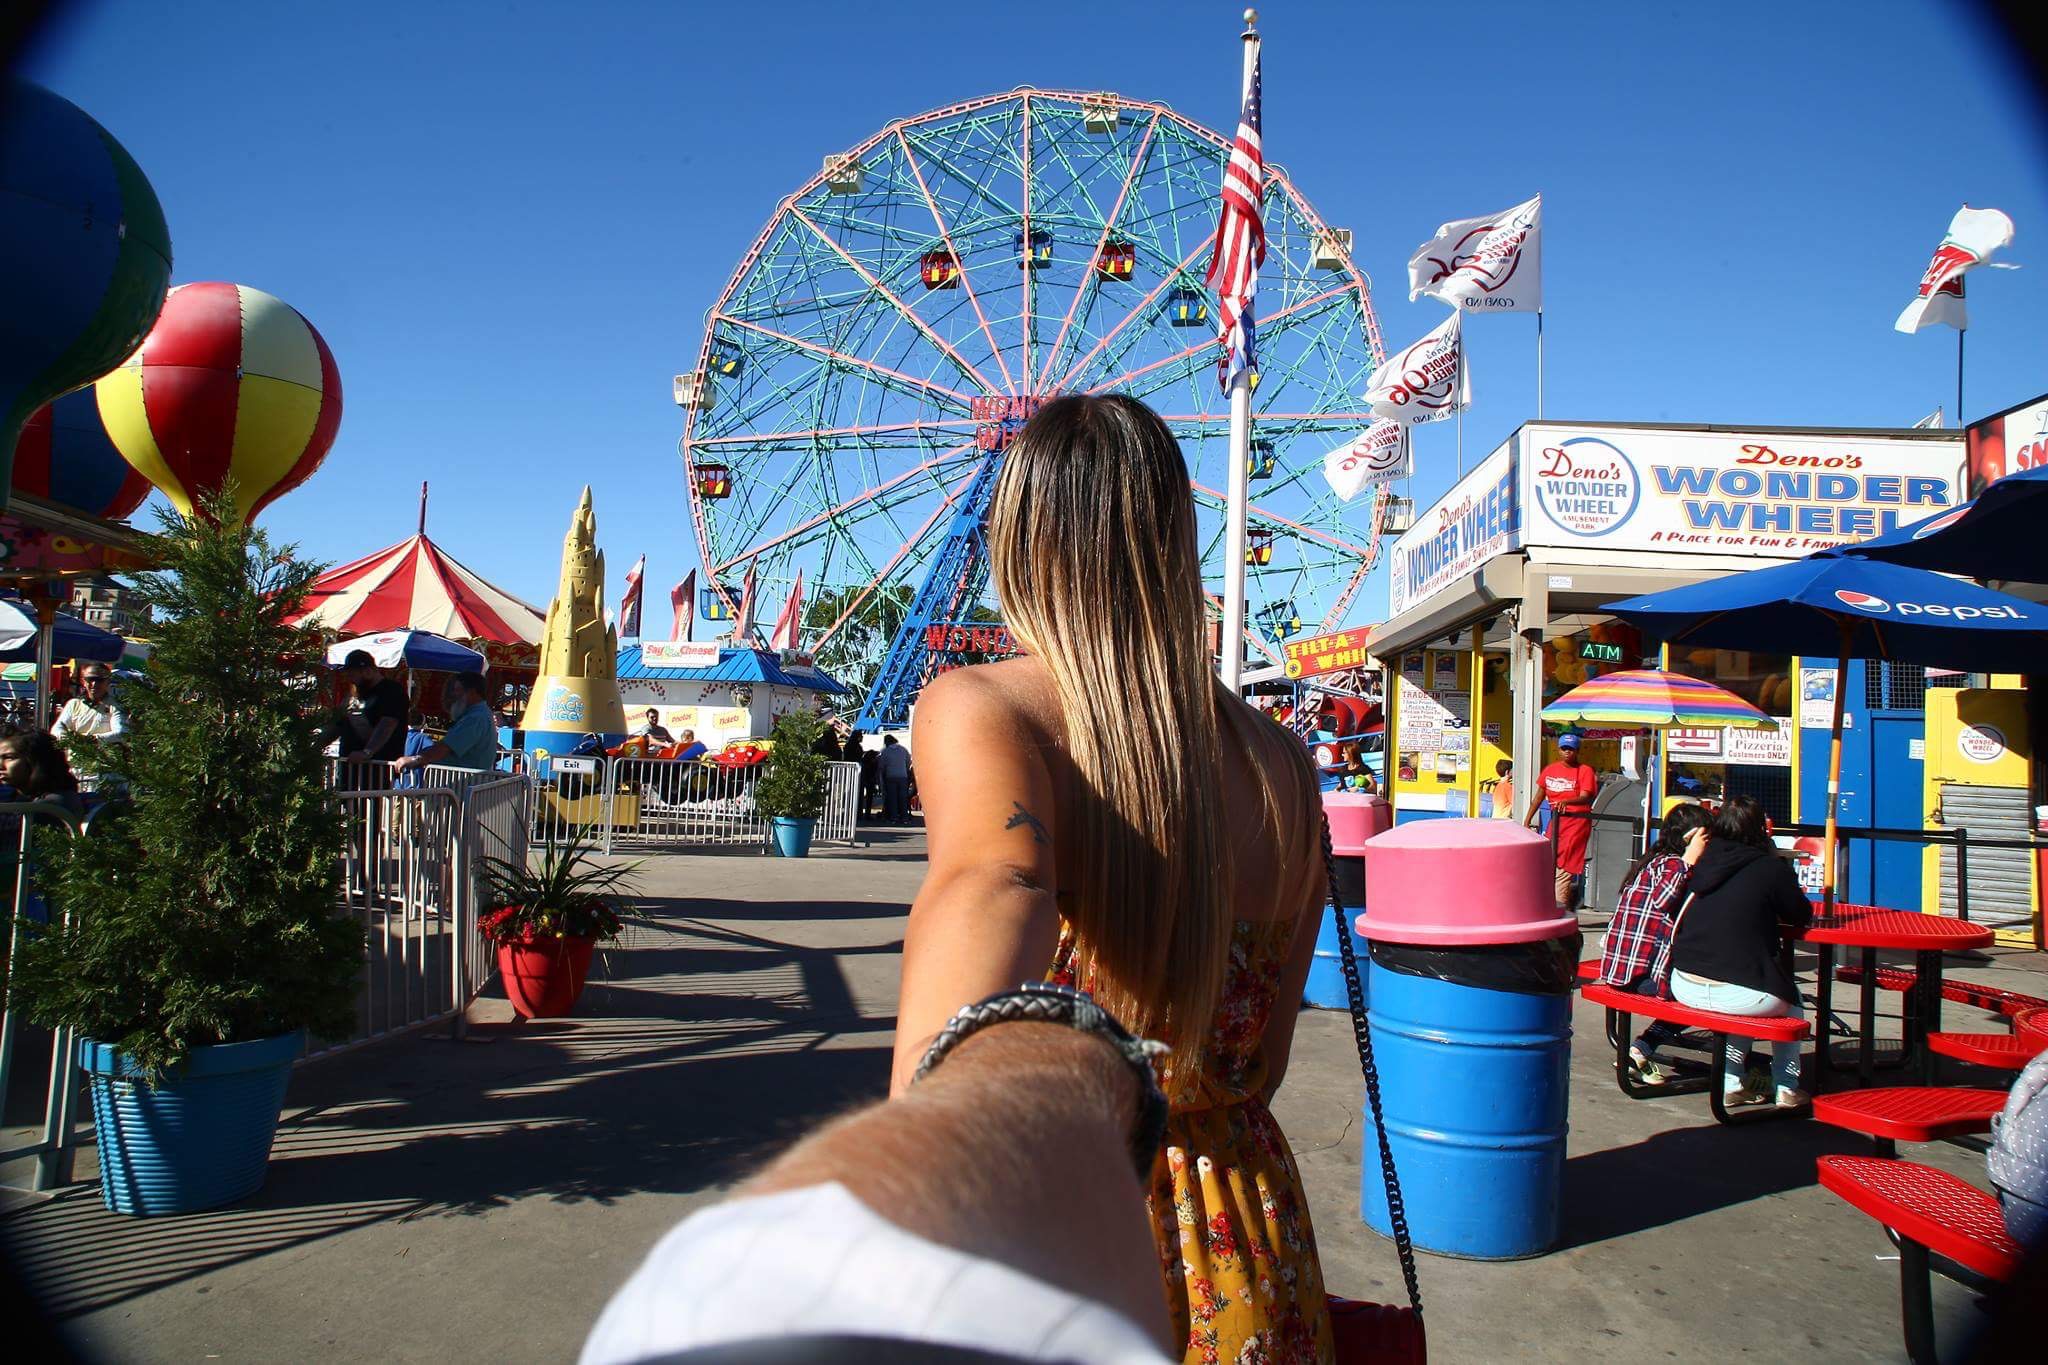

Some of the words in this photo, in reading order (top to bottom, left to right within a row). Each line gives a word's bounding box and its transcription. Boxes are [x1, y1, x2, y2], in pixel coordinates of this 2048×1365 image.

[1539, 447, 1620, 480] Deno's
[1736, 445, 1863, 469] Deno's
[1547, 480, 1627, 498] WONDER
[1651, 465, 1951, 506] WONDER
[1439, 496, 1471, 532] Deno's
[1556, 498, 1618, 515] WHEEL
[1562, 515, 1609, 524] AMUSEMENT
[1651, 532, 1662, 542] A
[1666, 532, 1711, 545] PLACE
[1717, 535, 1743, 545] FOR
[1749, 536, 1780, 548] FUN
[1785, 537, 1797, 548] &
[1802, 538, 1847, 550] FAMI
[1408, 525, 1458, 599] WONDER
[1440, 570, 1449, 585] FUN
[1455, 555, 1472, 576] FAMILY
[1473, 545, 1487, 563] SINCE
[1895, 602, 2029, 621] pepsi
[927, 624, 1014, 653] WOND
[646, 644, 663, 656] Say
[679, 644, 716, 656] Cheese!
[1583, 643, 1620, 661] ATM
[671, 713, 691, 723] Photos
[719, 714, 740, 726] Tickets
[630, 746, 641, 758] 2
[1623, 741, 1633, 750] ATM
[1735, 740, 1783, 751] Pizzeria
[1728, 750, 1765, 759] Customers
[1767, 752, 1788, 760] ONLY!
[564, 761, 580, 769] Exit
[1799, 865, 1825, 888] CEE
